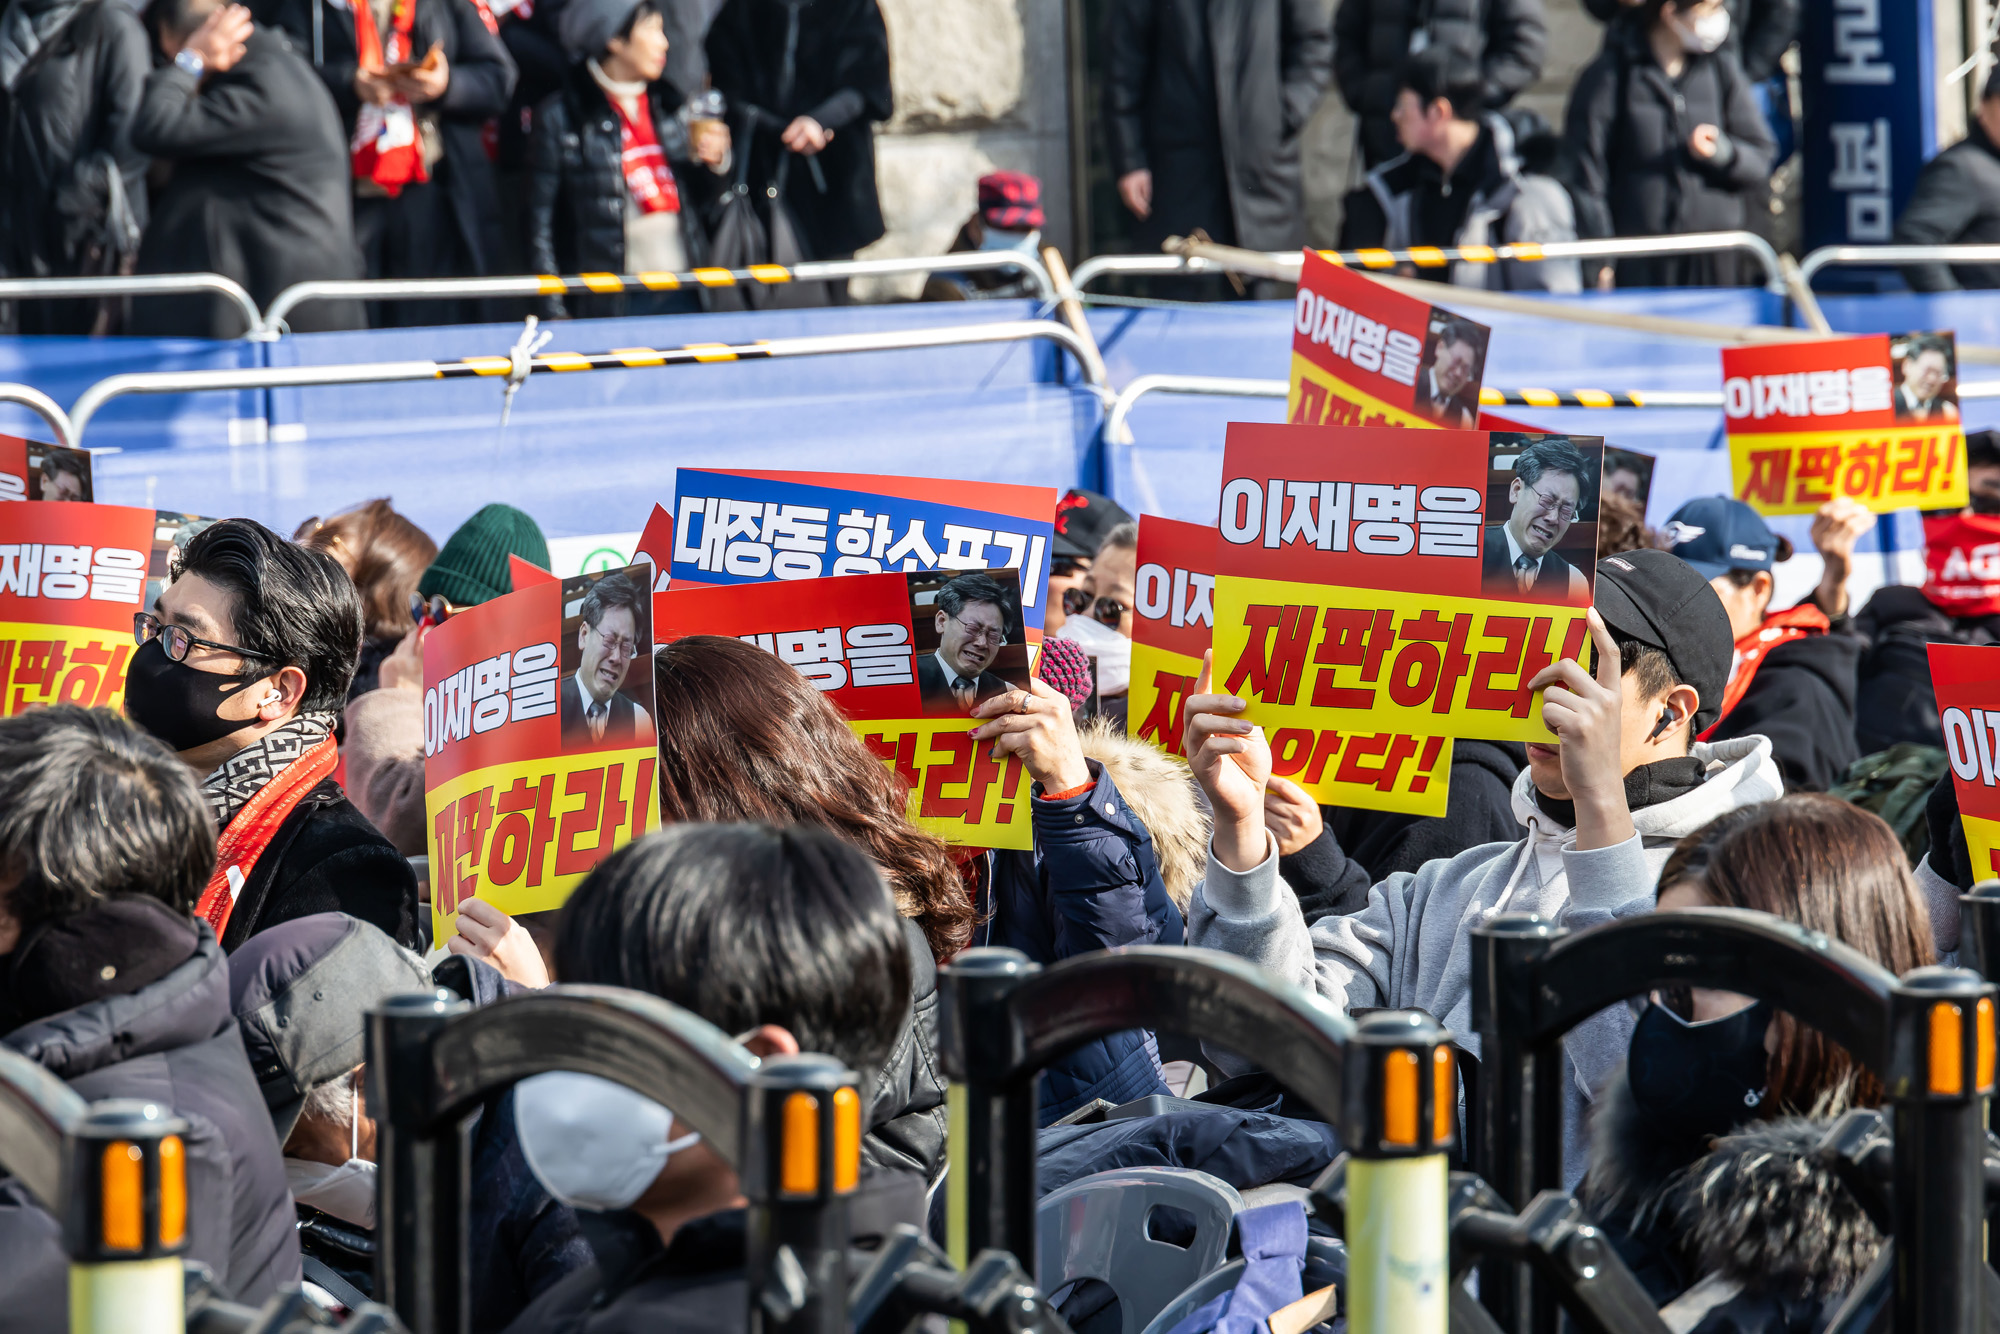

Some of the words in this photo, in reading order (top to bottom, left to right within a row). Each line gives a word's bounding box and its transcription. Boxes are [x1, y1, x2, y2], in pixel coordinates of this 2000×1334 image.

[1295, 287, 1422, 387] 이재명을
[1724, 366, 1894, 419] 이재명을
[1740, 434, 1959, 505] 재판하라!
[673, 495, 829, 578] 대장동
[1218, 477, 1482, 558] 이재명을
[738, 622, 914, 691] 명을
[1224, 603, 1588, 719] 재판하라!
[424, 641, 559, 759] 이재명을
